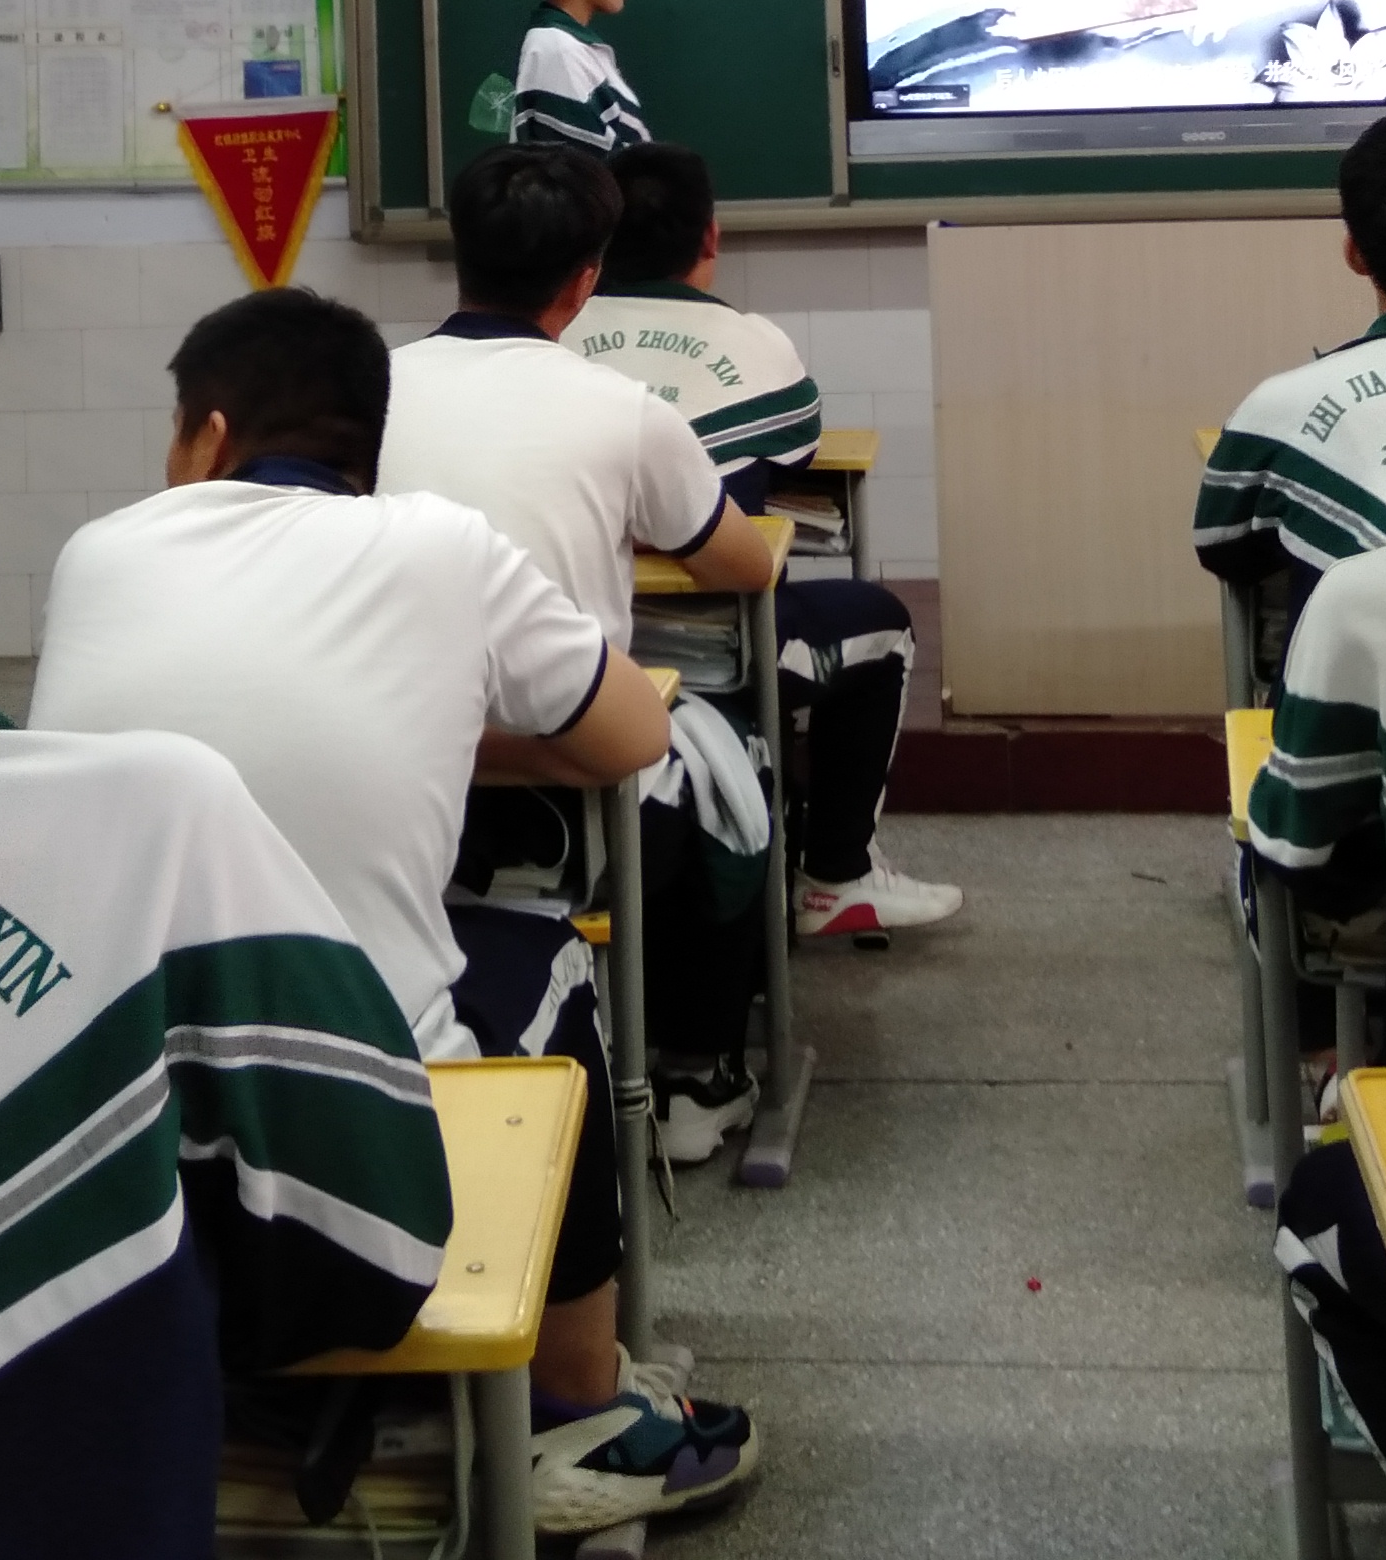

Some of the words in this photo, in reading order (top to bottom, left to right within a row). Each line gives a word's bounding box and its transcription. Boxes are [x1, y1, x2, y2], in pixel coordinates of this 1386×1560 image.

[242, 146, 278, 163] 卫生
[582, 330, 626, 357] JIAO
[635, 329, 708, 359] ZHONG
[706, 355, 745, 388] XIN
[1300, 394, 1348, 443] ZHI
